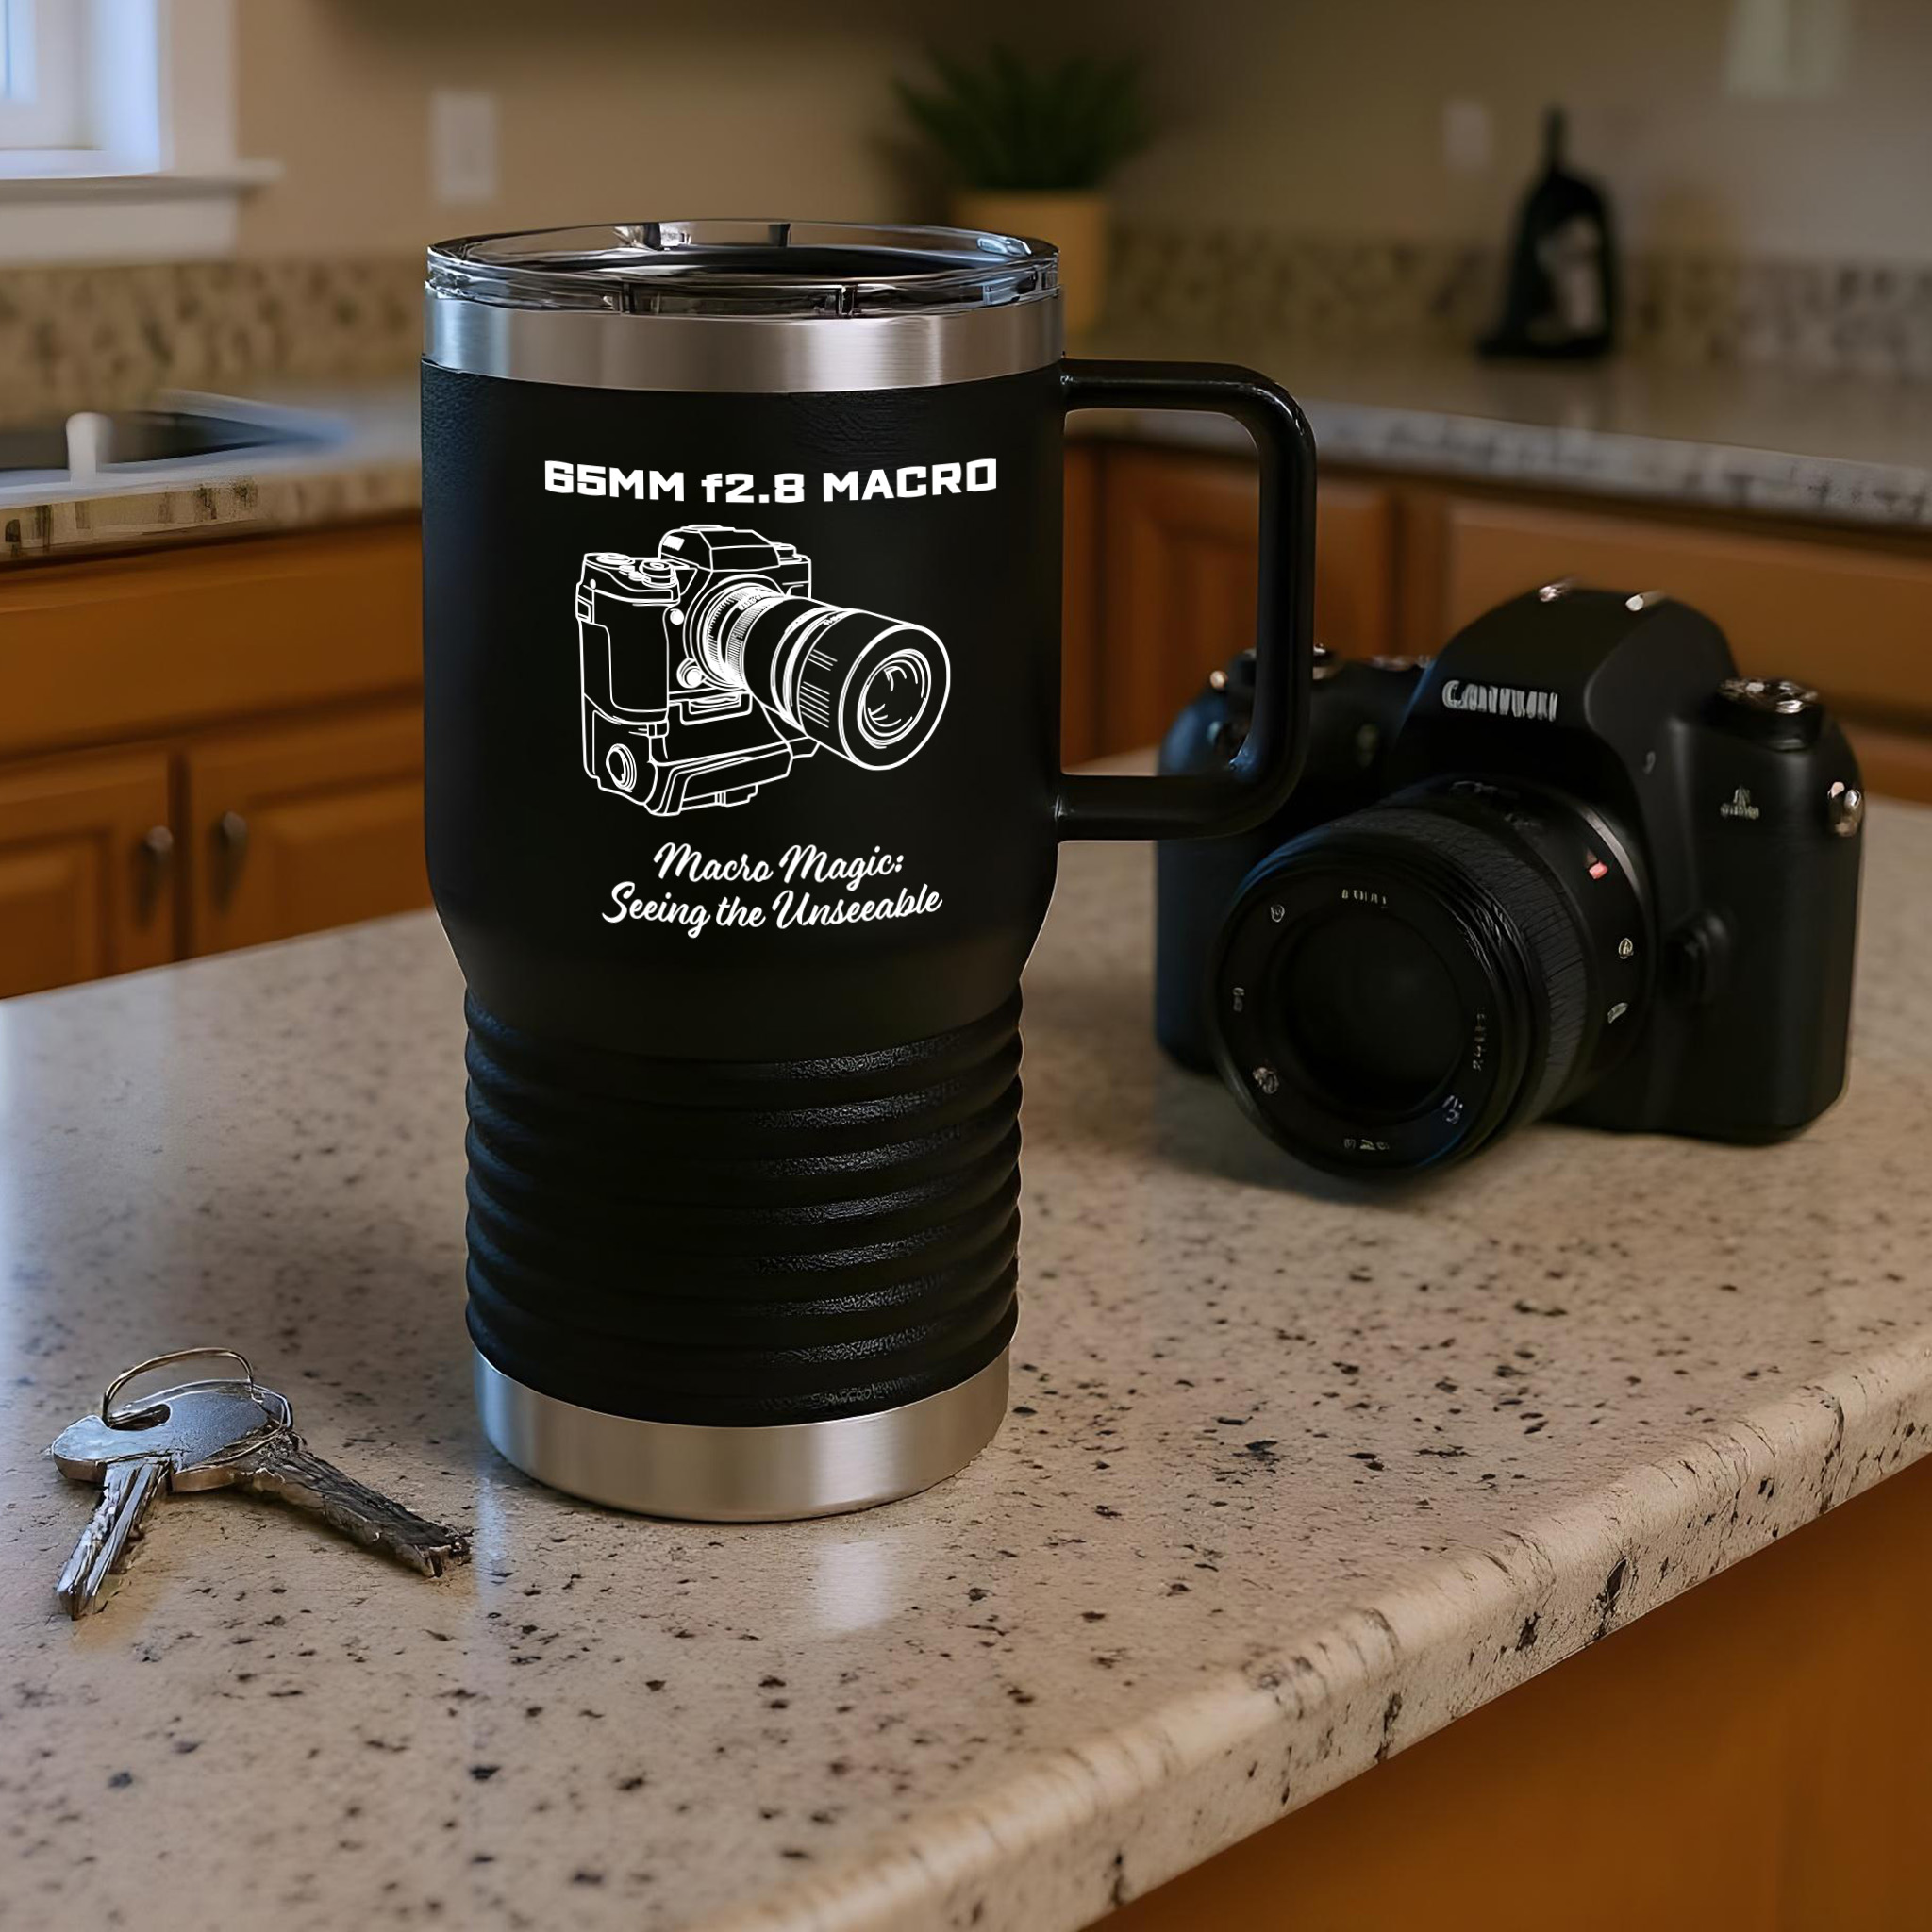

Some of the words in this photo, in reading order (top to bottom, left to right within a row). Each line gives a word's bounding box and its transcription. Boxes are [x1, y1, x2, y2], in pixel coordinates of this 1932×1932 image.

[544, 459, 685, 502] 65MM
[701, 472, 805, 504] f2.8
[823, 458, 997, 502] MACRO
[653, 841, 773, 882] Macro
[778, 843, 905, 891] Magic:
[601, 881, 710, 939] Seeing
[715, 895, 766, 928] the
[771, 883, 943, 930] Unseeable
